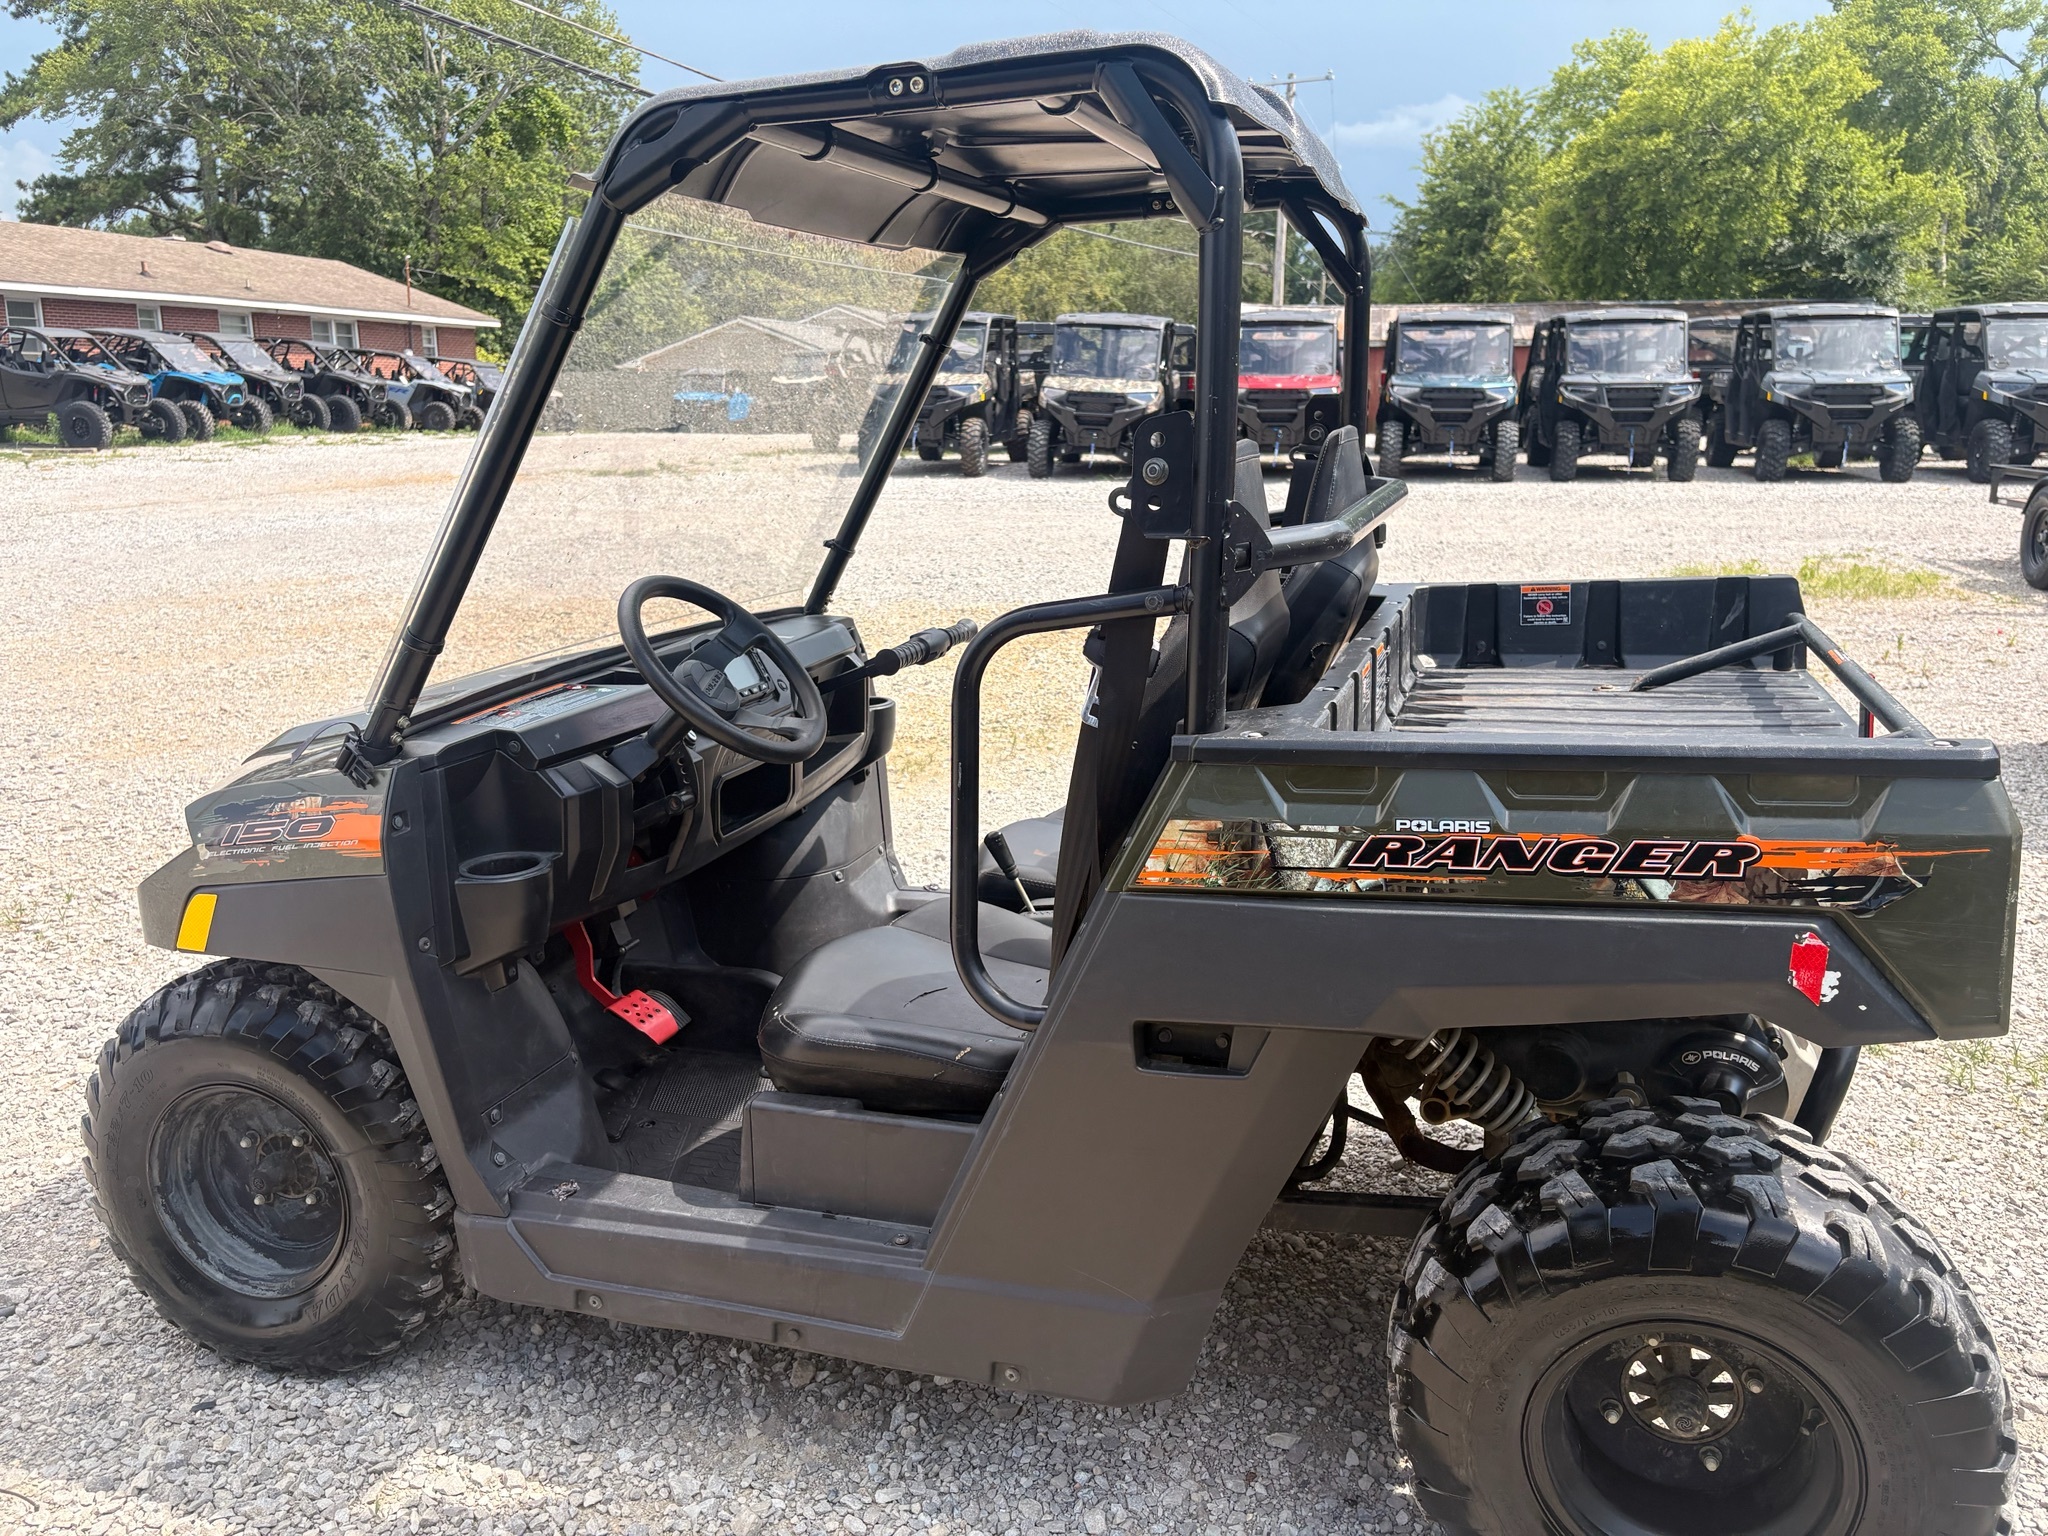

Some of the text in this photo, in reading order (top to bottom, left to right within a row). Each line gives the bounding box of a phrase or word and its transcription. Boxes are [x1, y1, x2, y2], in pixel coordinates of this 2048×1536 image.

[220, 815, 336, 847] 150
[1395, 818, 1492, 834] POLARIS
[208, 839, 359, 857] ELECTRONIC FUEL INJECTION
[1348, 834, 1763, 880] RANGER
[1702, 1050, 1761, 1072] POLARIS
[304, 1216, 369, 1325] WANDA
